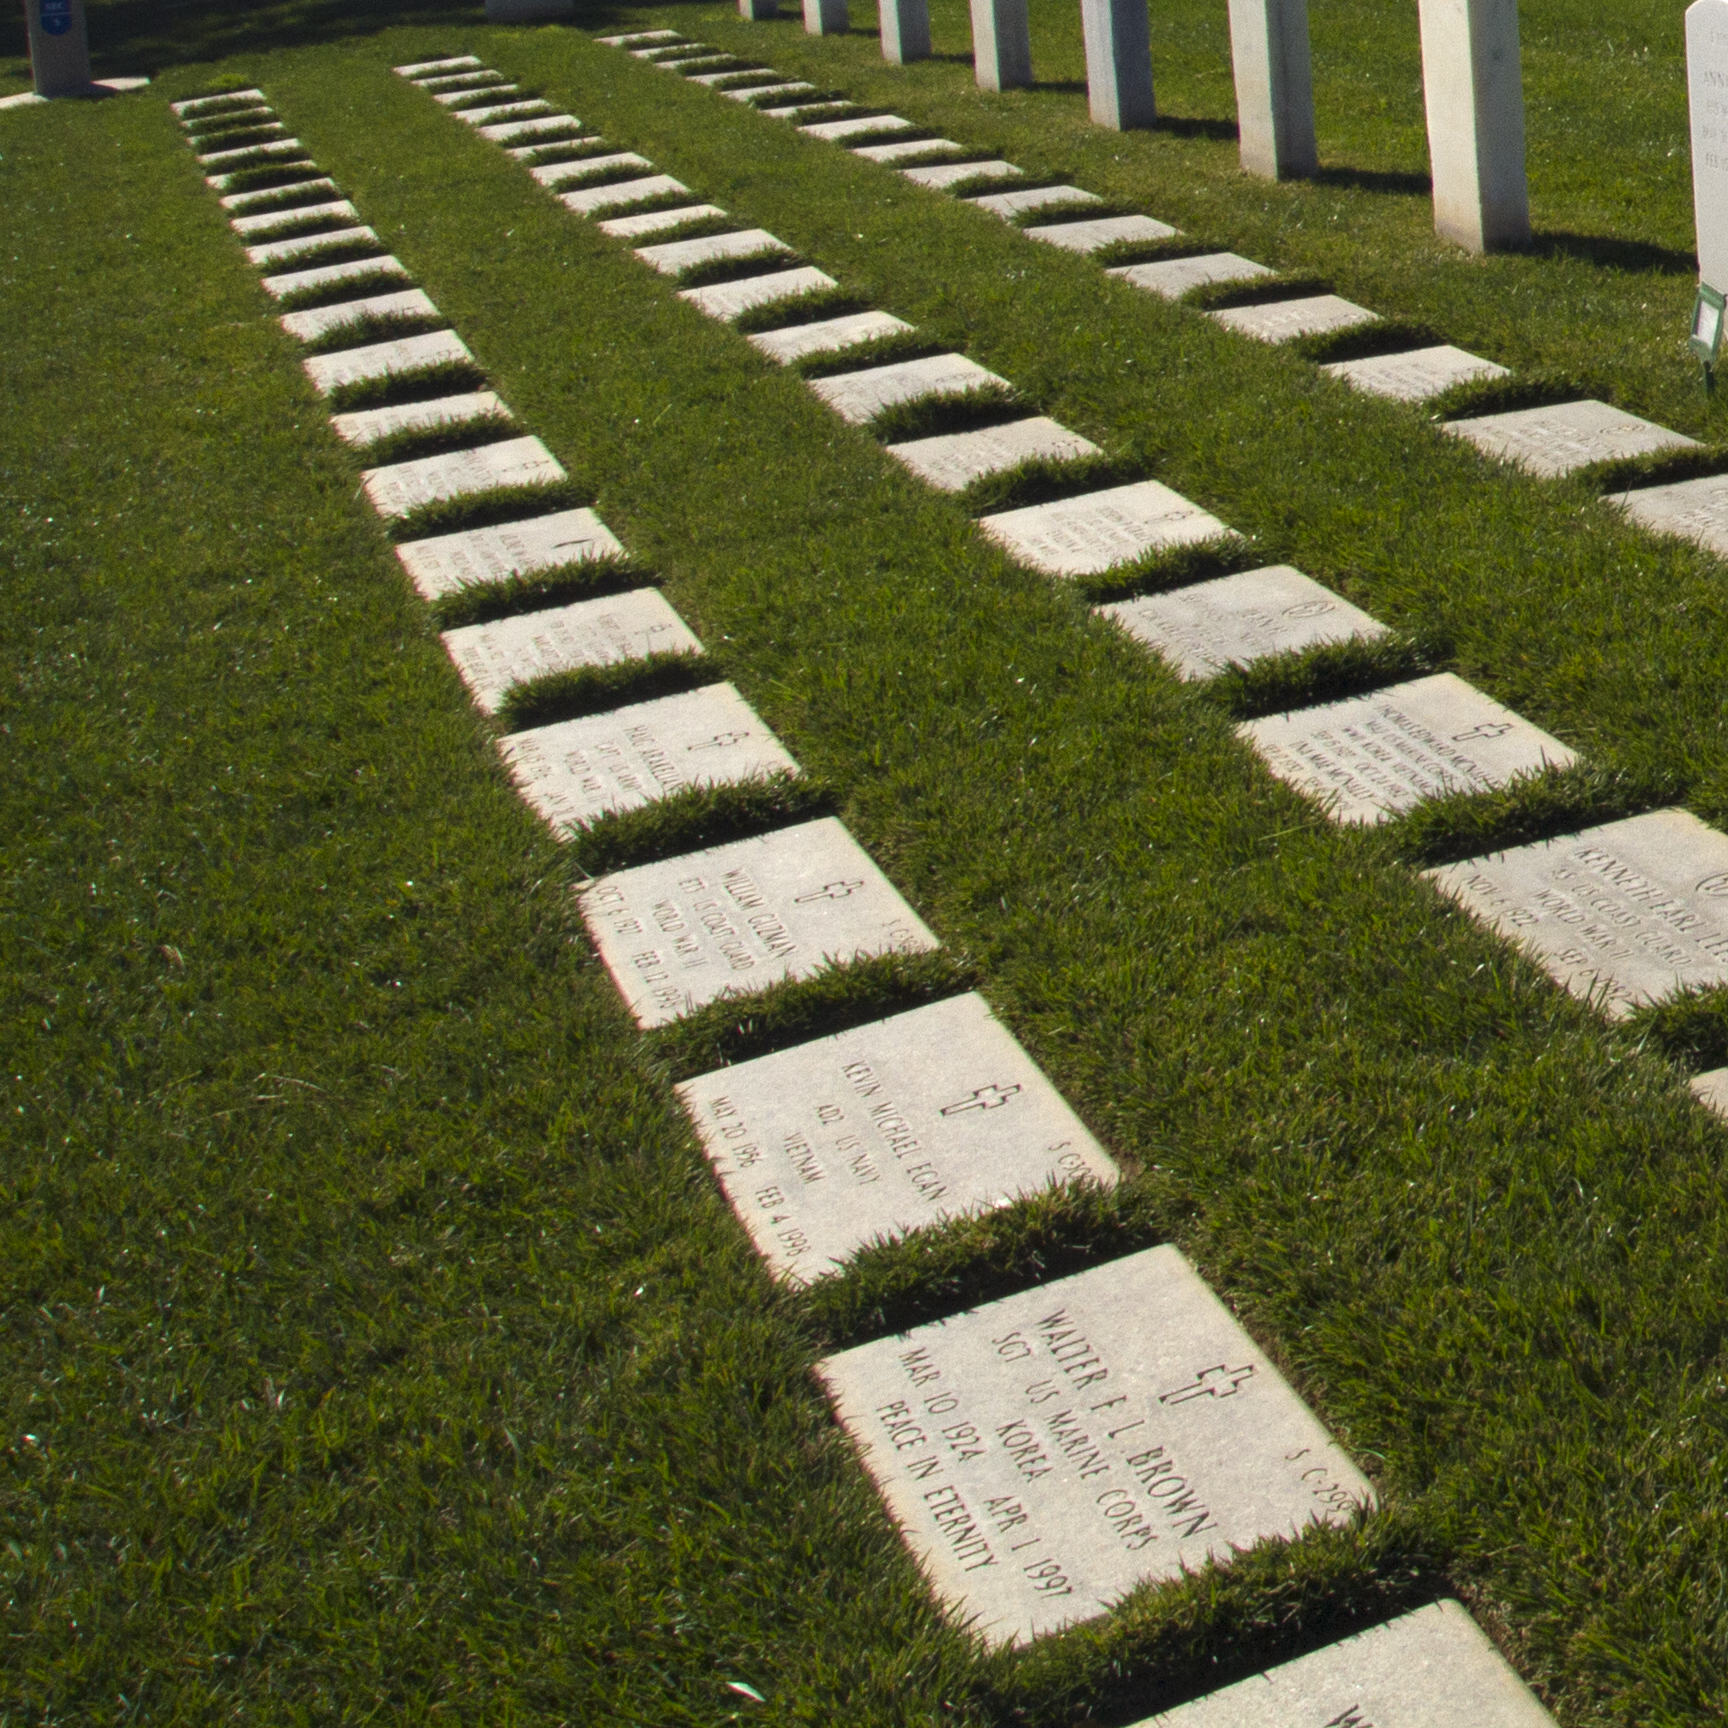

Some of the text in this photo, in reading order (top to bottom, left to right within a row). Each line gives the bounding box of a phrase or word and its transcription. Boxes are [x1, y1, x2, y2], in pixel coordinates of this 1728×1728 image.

[1373, 704, 1457, 757] THOMAS EDWARD
[717, 867, 800, 959] WILLIAM GUZMAN
[1459, 875, 1501, 897] NOV
[1570, 847, 1667, 901] KENNETH
[1646, 900, 1710, 932] EARL
[596, 884, 659, 969] OCT FEB
[649, 899, 699, 956] WORLD WAR
[700, 911, 755, 972] COAST GUARD
[1528, 890, 1621, 949] WORLD WAR
[1569, 883, 1698, 967] US COAST GUARD
[704, 1095, 739, 1121] MAY
[720, 1121, 750, 1140] 20
[839, 1060, 955, 1203] KEVIN MICHAEL EGAN
[730, 1142, 766, 1168] 1956
[775, 1132, 831, 1184] VIETNAM
[811, 1102, 884, 1186] AD2 US NAVY
[753, 1184, 787, 1209] FEB
[775, 1227, 814, 1258] 1998
[894, 1347, 943, 1387] MAR
[922, 1391, 960, 1416] 10
[1026, 1310, 1115, 1391] WALTER
[1122, 1446, 1222, 1540] BROWN
[938, 1421, 989, 1462] 1924
[989, 1331, 1162, 1552] SGT US MARINE CORPS
[990, 1420, 1058, 1483] KOREA
[872, 1400, 1002, 1575] PEACE IN ETERNITY
[980, 1492, 1029, 1532] APR
[1021, 1557, 1074, 1602] 1997
